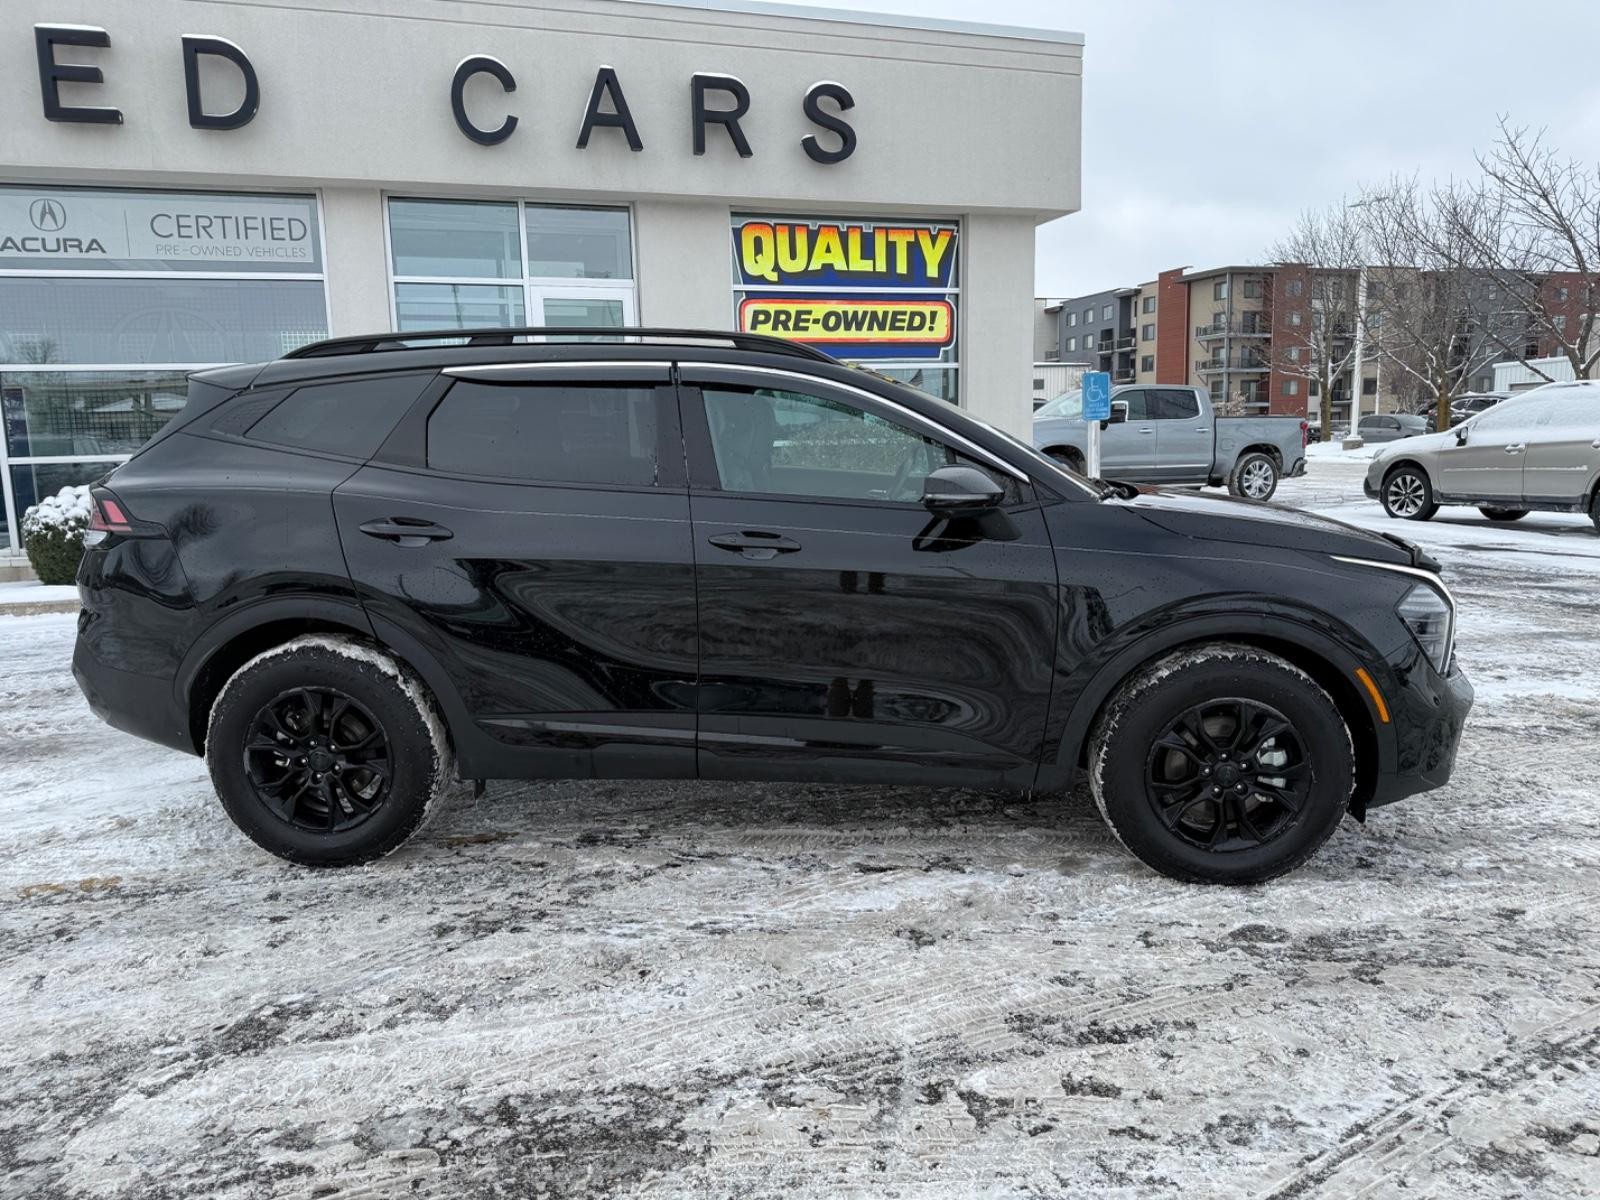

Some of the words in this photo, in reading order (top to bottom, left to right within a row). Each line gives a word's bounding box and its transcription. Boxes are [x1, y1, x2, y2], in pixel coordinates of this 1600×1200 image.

[34, 23, 259, 129] ED
[451, 54, 857, 164] CARS
[151, 213, 307, 241] CERTIFIED
[0, 236, 107, 254] ACURA
[155, 245, 242, 257] PRE-OWNED
[247, 247, 307, 258] VEHICLES
[741, 223, 952, 281] QUALITY
[750, 309, 938, 332] PRE-OWNED!
